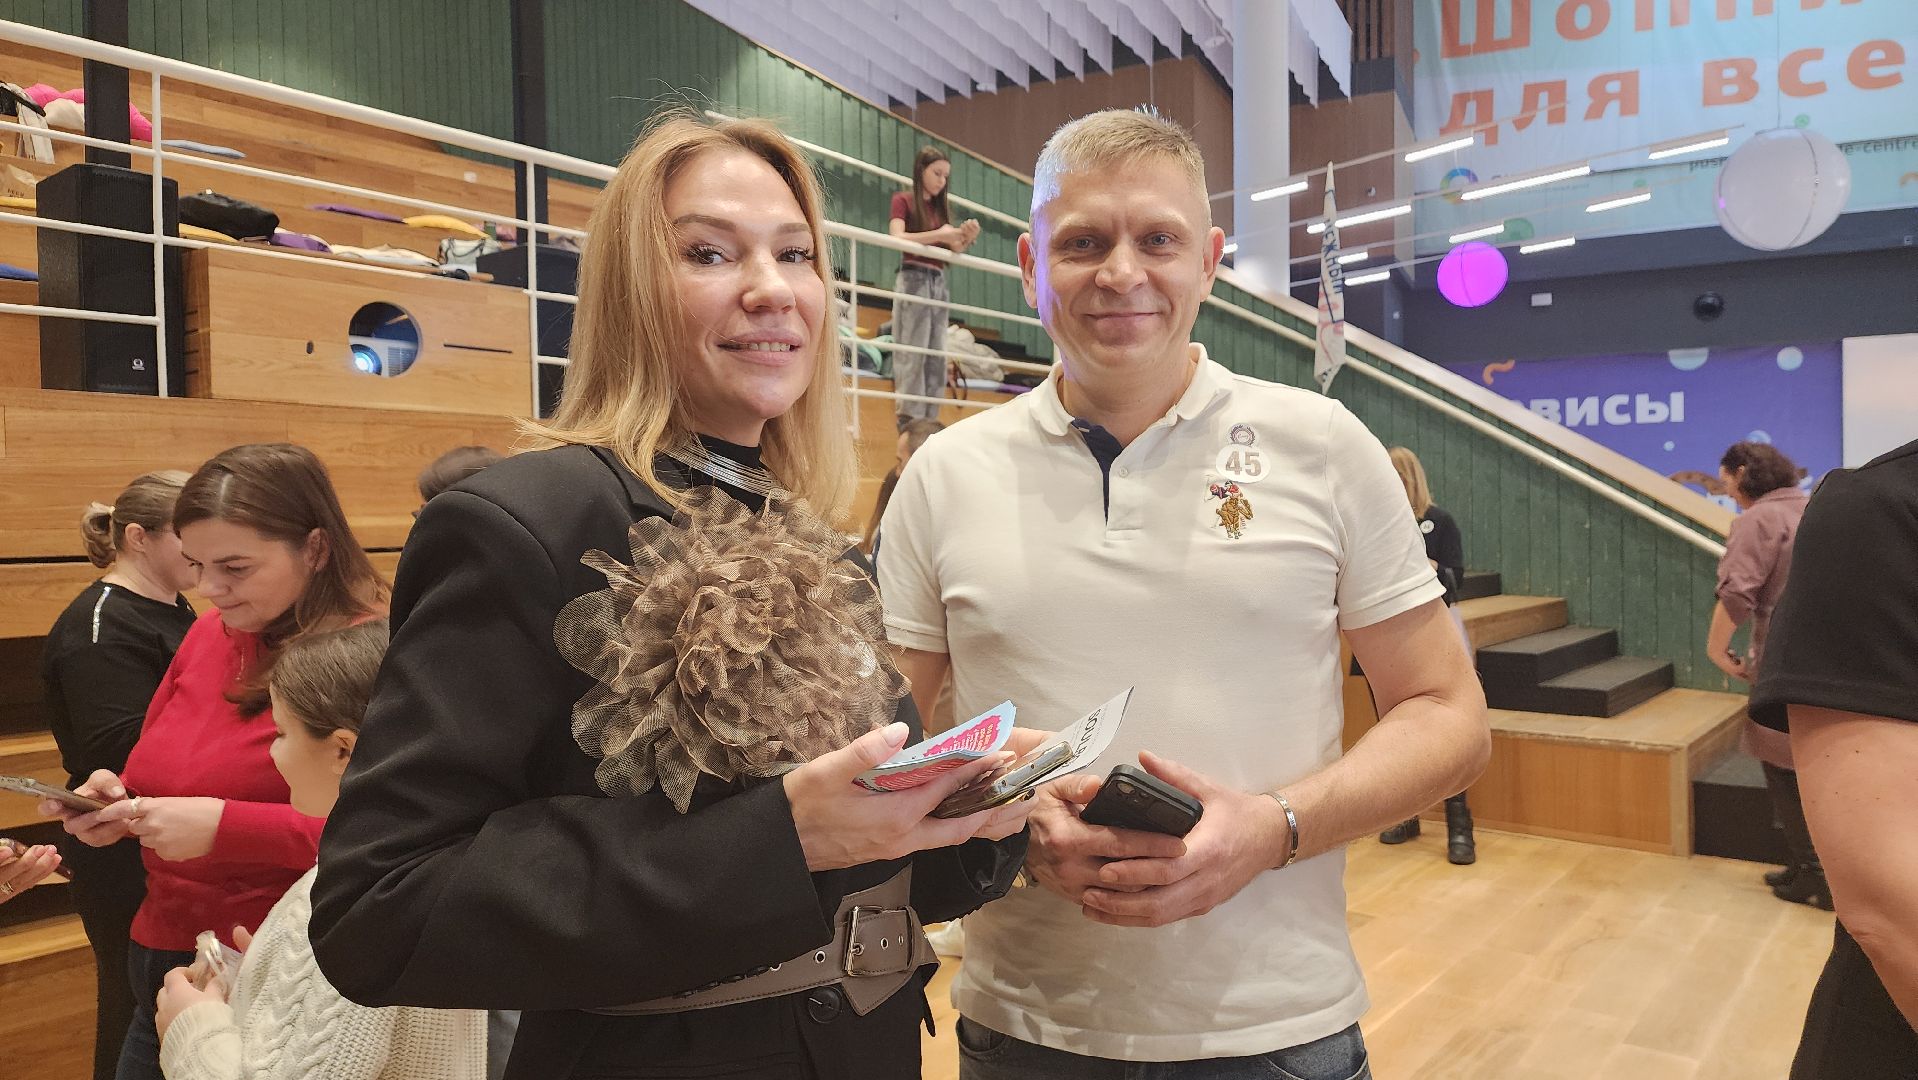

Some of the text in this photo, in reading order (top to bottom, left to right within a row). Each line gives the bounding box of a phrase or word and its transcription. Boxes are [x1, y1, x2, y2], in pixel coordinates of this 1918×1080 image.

[1440, 0, 1864, 59] Шоп
[1439, 39, 1906, 146] для все
[1515, 391, 1685, 427] висы
[1225, 450, 1262, 477] 45
